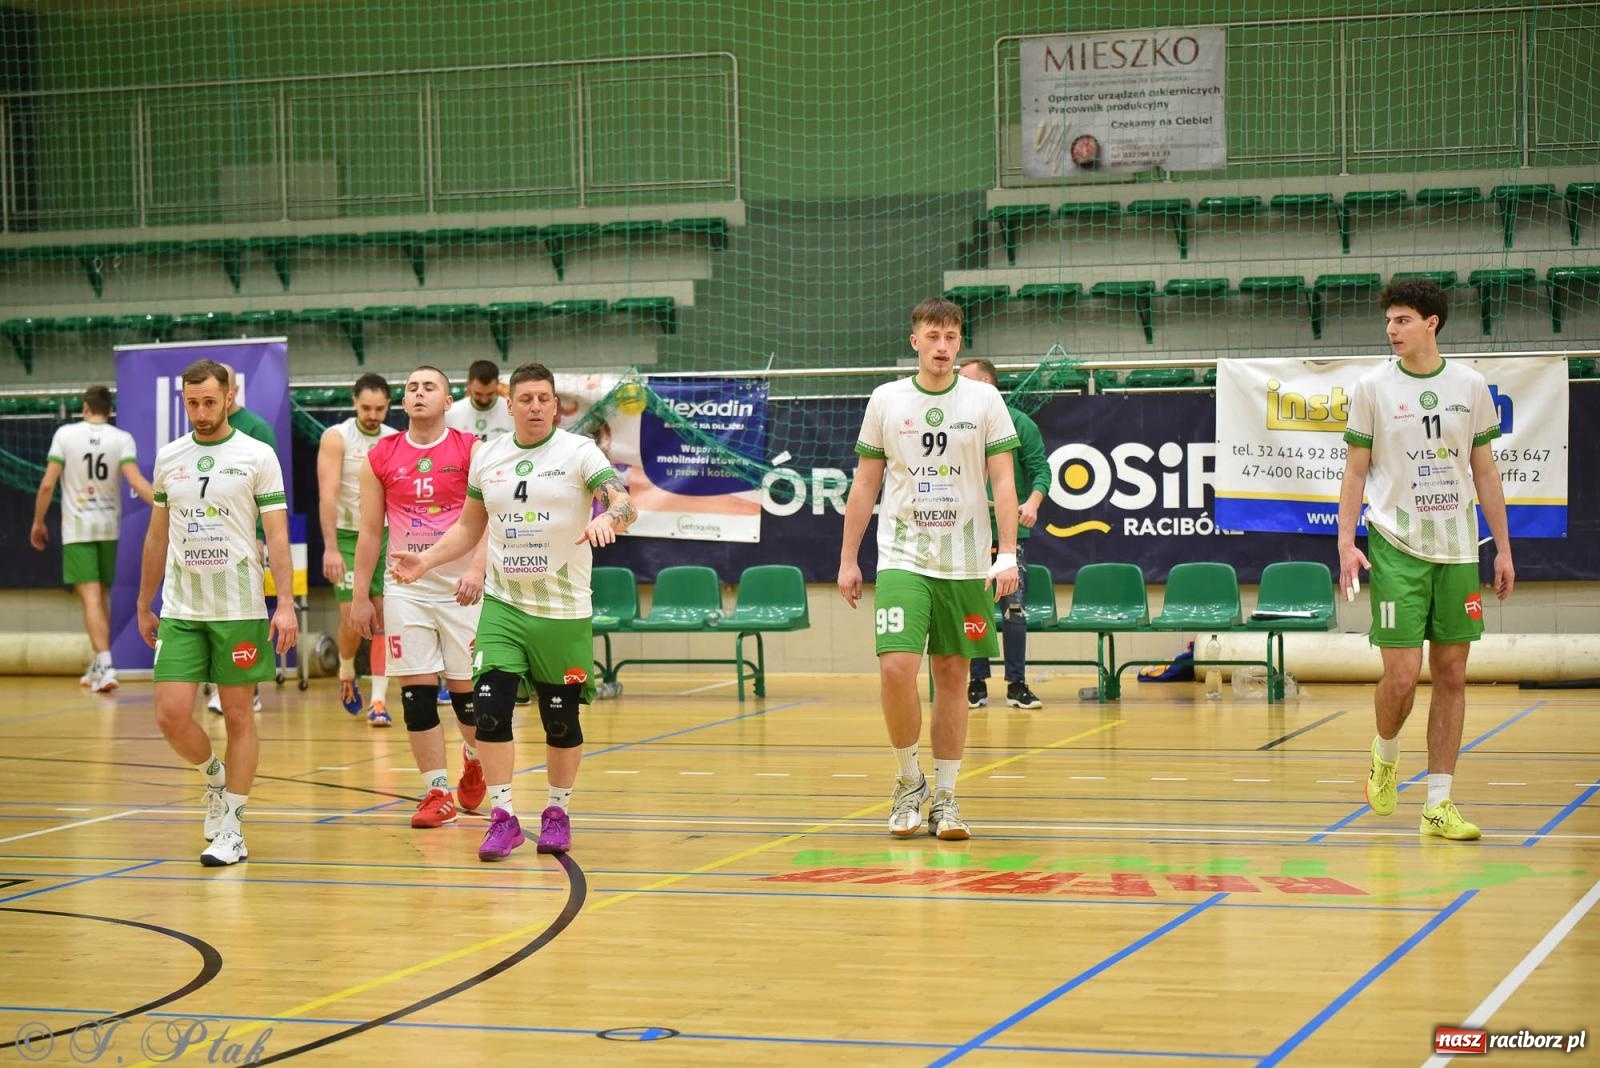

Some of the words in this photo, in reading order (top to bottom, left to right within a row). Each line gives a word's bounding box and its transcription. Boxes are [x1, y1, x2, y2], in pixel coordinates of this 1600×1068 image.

[1045, 36, 1199, 72] MIESZKO
[1048, 93, 1094, 104] Operator
[1149, 86, 1220, 97] cukierniczych
[1048, 104, 1103, 115] Pracownik
[1106, 101, 1169, 113] produkcyjny
[1160, 118, 1172, 126] na
[1267, 378, 1350, 432] inst
[1421, 414, 1442, 440] 11
[922, 432, 948, 457] 99
[1232, 444, 1253, 456] tel.
[1258, 445, 1273, 457] 32
[1278, 447, 1303, 459] 414
[1308, 448, 1325, 460] 92
[1406, 448, 1459, 461] VISON
[1523, 449, 1551, 462] 647
[83, 453, 108, 481] 16
[907, 465, 961, 477] VISON
[1242, 465, 1292, 478] 47-400
[1296, 466, 1344, 480] Racibó
[1501, 469, 1527, 482] rffa
[1532, 470, 1540, 482] 2
[199, 476, 210, 499] 7
[413, 477, 434, 498] 15
[513, 480, 528, 503] 4
[1415, 493, 1459, 505] PIVEXIN
[180, 508, 229, 518] VISON
[914, 510, 957, 521] PIVEXIN
[1415, 504, 1459, 513] TECHNOLOGY
[497, 511, 550, 523] VISON
[915, 520, 956, 528] TECHNOLOGY
[184, 549, 229, 560] PIVEXIN
[503, 556, 548, 567] PIVEXIN
[503, 566, 548, 574] TECHNOLOGY
[876, 607, 905, 635] 99
[1380, 601, 1396, 629] 11
[963, 622, 987, 634] RV
[231, 647, 257, 662] RV
[389, 636, 402, 659] 15
